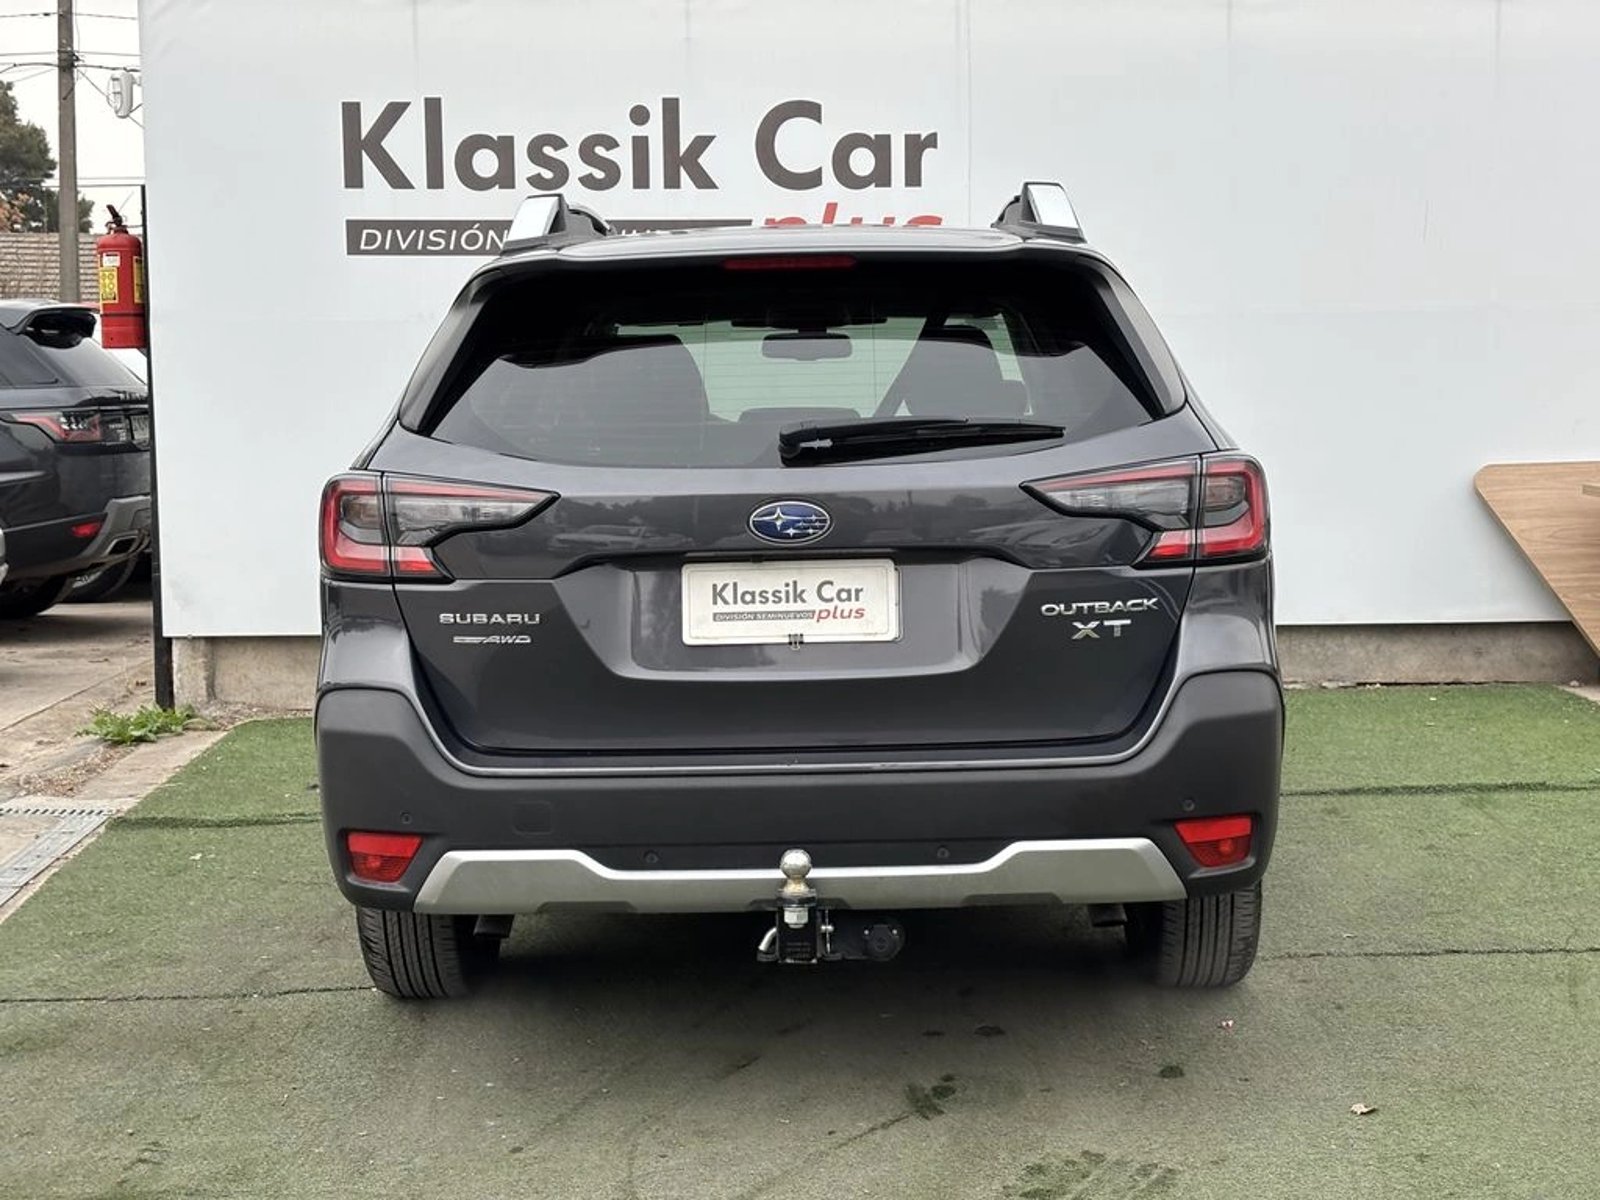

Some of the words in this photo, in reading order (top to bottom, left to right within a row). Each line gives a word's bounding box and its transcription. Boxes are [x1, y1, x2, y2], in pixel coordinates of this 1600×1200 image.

[341, 96, 720, 190] Klassik
[755, 99, 938, 190] Car
[359, 222, 508, 251] DIVISIÓN
[712, 580, 808, 606] Klassik
[816, 580, 864, 603] Car
[814, 605, 866, 623] plus
[1041, 598, 1158, 616] OUTBACK
[439, 613, 540, 624] SUBARU
[483, 635, 532, 643] AWD
[1071, 619, 1132, 640] XT
